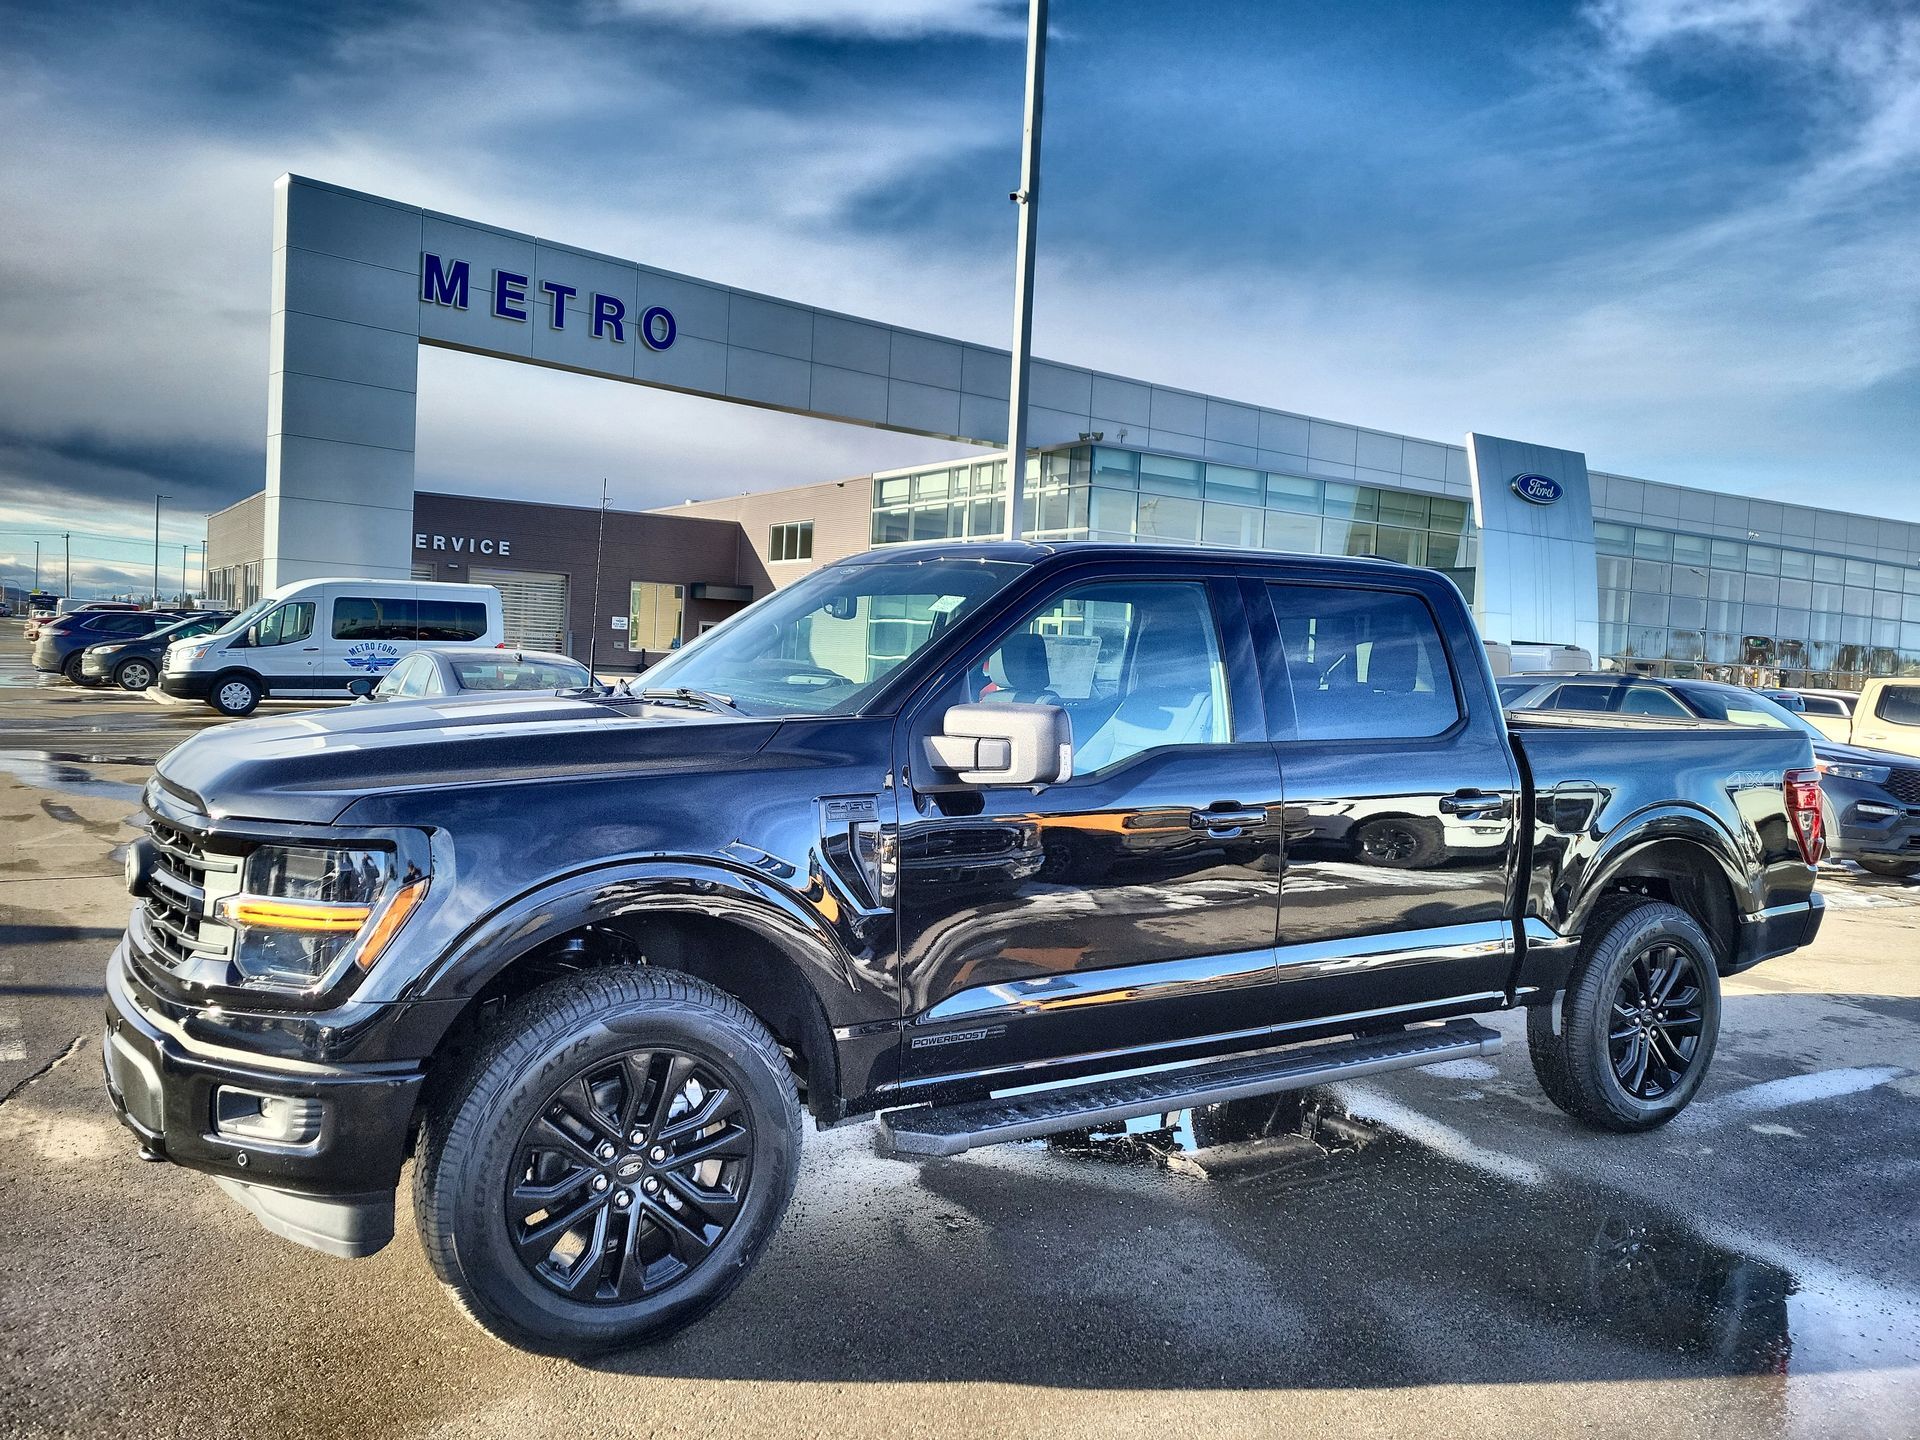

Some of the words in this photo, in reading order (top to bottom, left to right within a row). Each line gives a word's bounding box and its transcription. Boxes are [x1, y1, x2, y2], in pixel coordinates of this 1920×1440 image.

[421, 252, 677, 351] METRO
[1527, 478, 1554, 498] Ford
[415, 533, 511, 556] ERVICE
[348, 642, 375, 656] METRO
[377, 642, 398, 656] FORD
[912, 1030, 987, 1048] POWERBOOST
